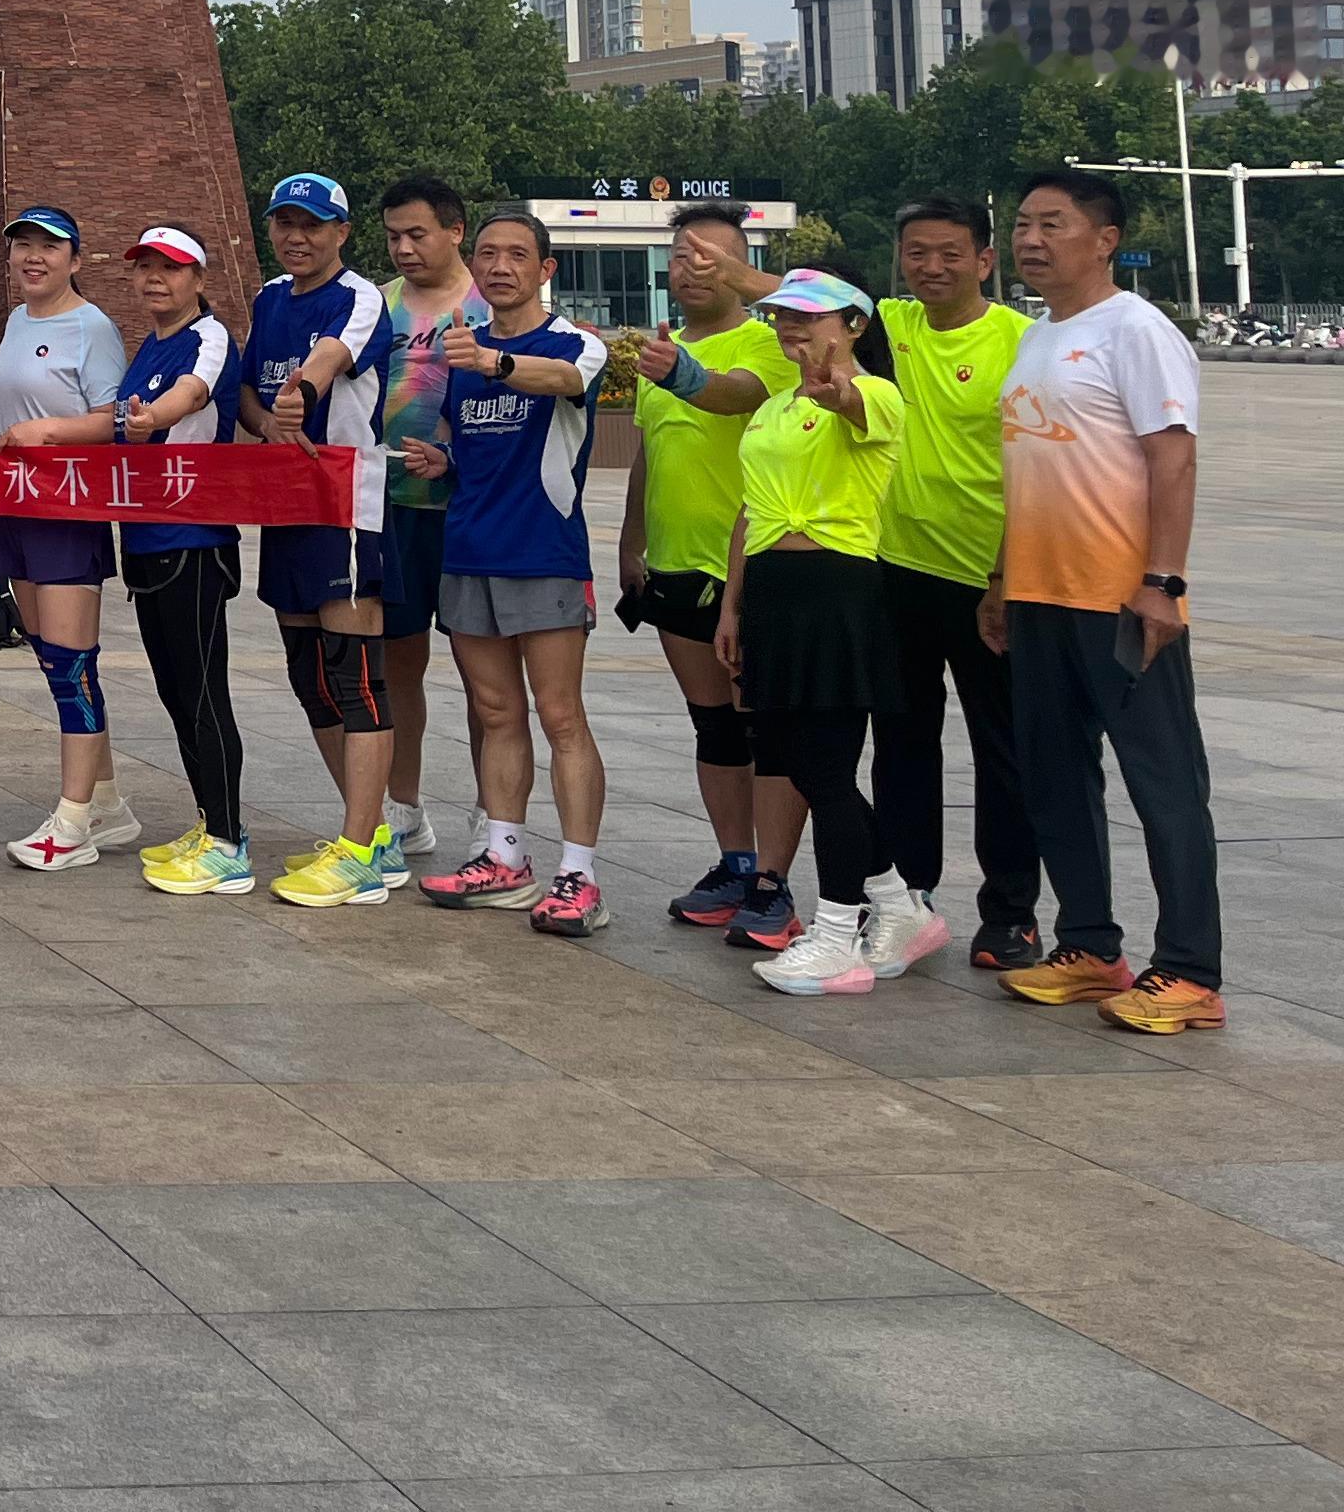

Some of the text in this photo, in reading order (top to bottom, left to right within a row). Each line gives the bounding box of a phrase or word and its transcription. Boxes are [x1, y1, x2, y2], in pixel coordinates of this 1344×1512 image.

[591, 178, 731, 198] 公安 POLICE
[460, 393, 536, 426] 黎明脚步
